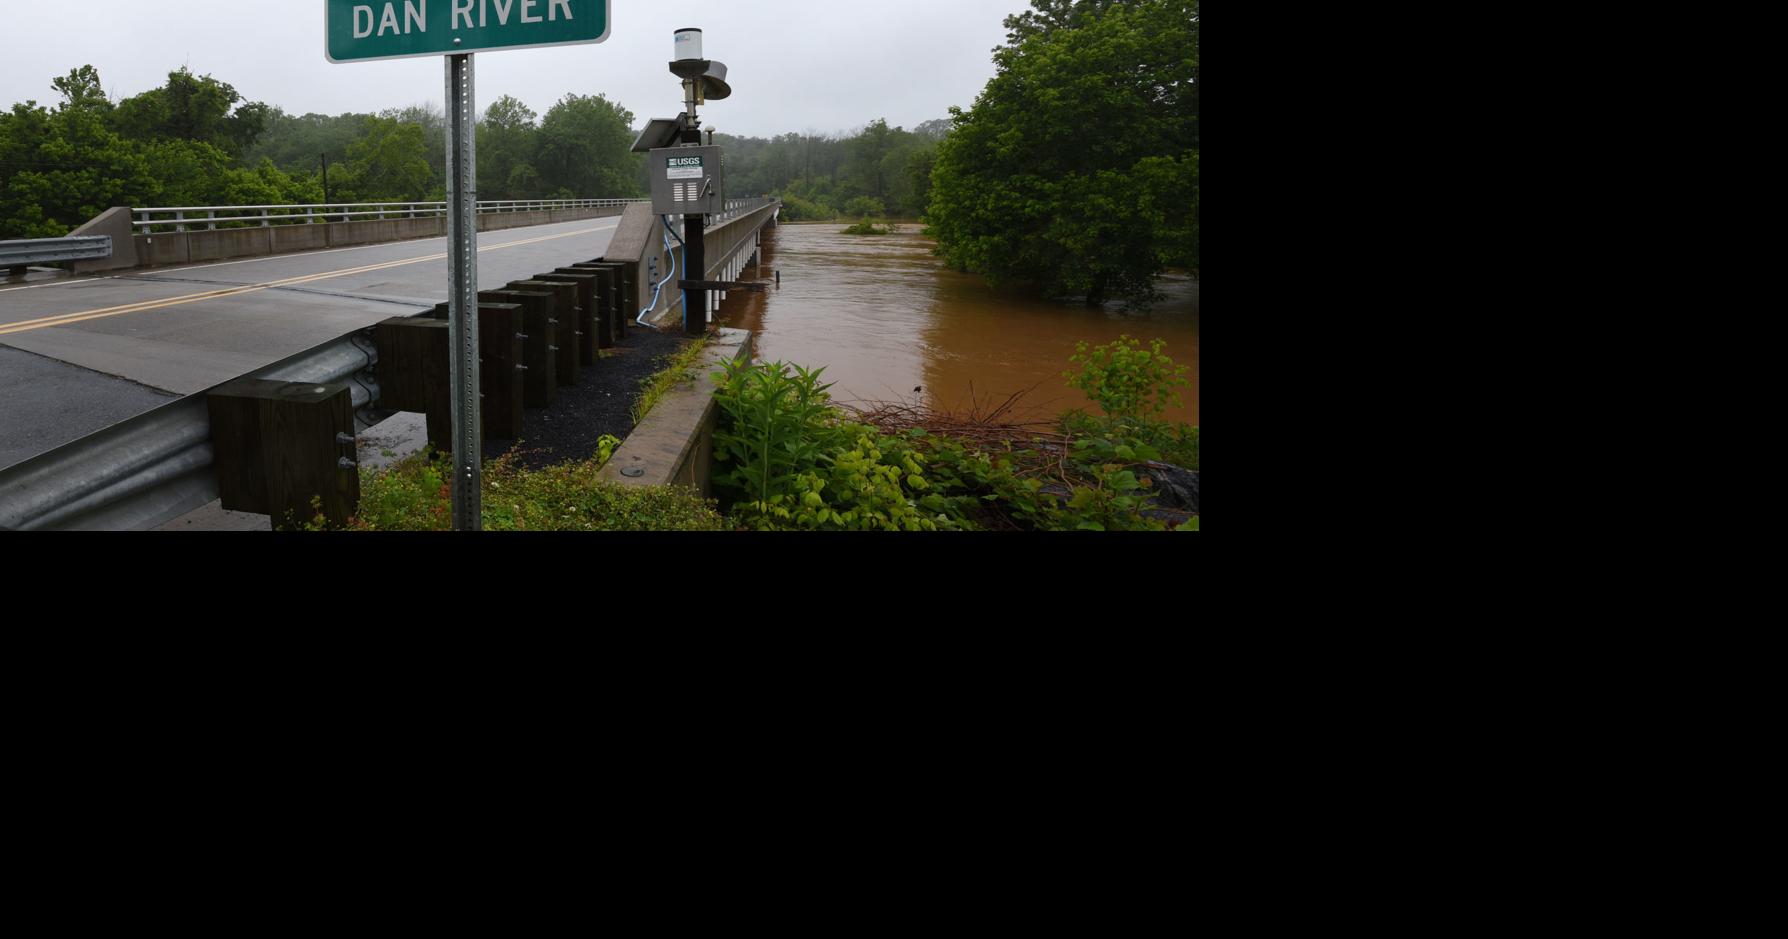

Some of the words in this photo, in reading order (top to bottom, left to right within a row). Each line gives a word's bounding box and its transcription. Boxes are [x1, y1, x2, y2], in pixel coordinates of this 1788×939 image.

[353, 0, 426, 38] DAN
[451, 0, 573, 30] RIVER
[677, 157, 700, 165] USGS
